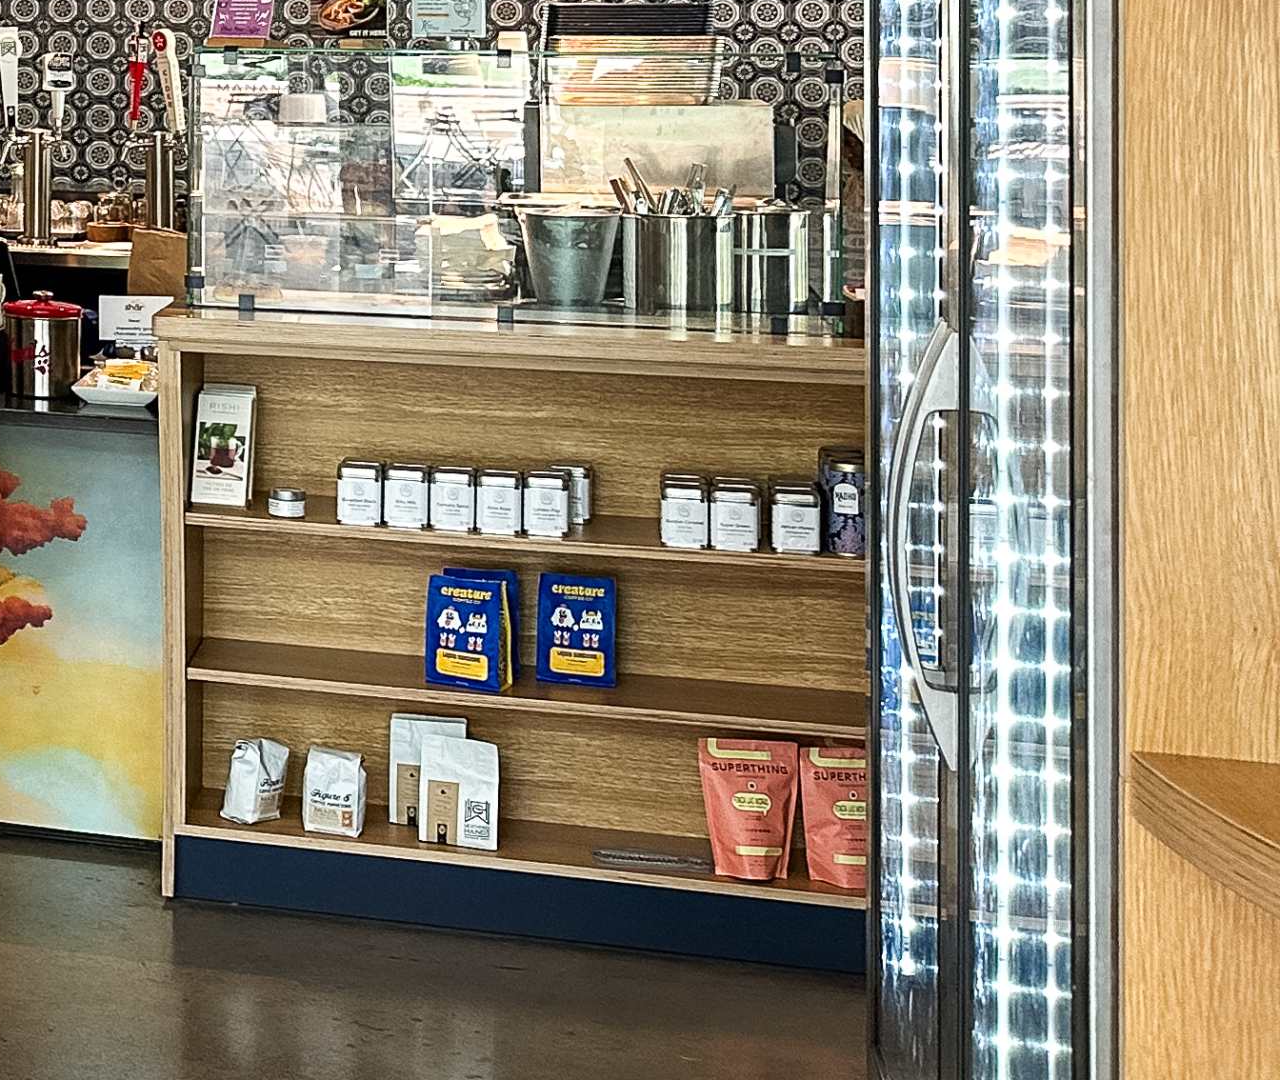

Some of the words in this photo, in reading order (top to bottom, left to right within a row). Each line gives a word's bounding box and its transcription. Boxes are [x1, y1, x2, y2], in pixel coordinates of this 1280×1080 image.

[440, 586, 493, 601] creature
[551, 584, 606, 598] creature
[711, 762, 789, 775] SUPERTHING
